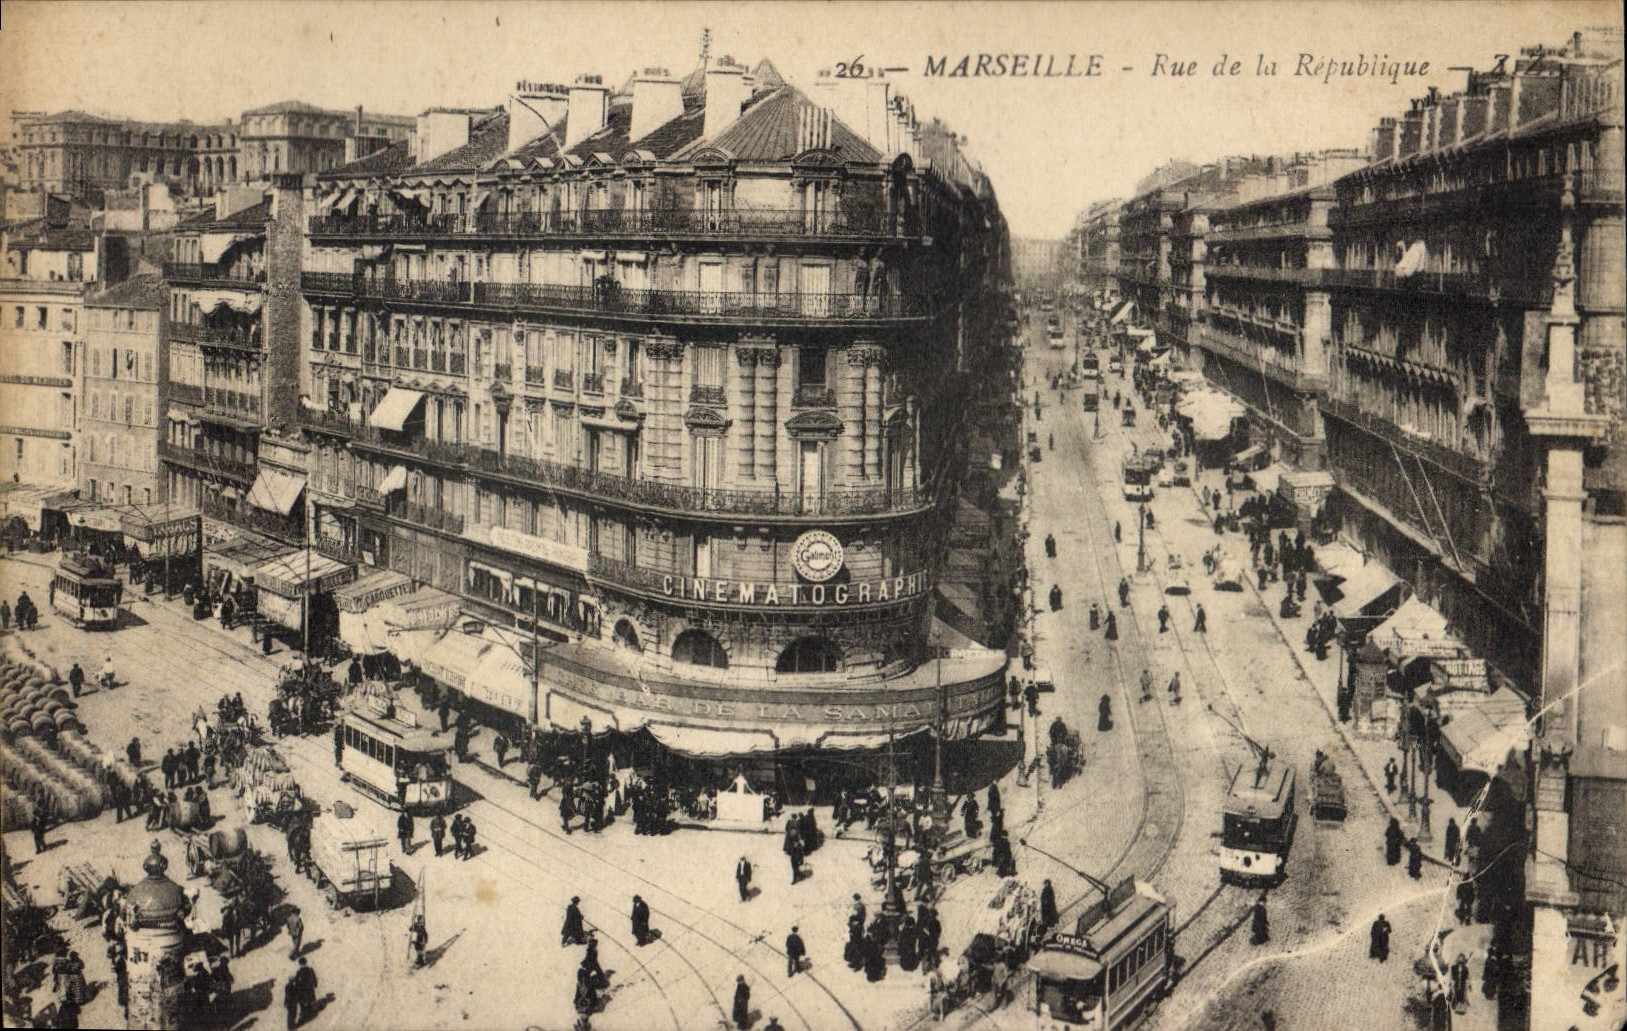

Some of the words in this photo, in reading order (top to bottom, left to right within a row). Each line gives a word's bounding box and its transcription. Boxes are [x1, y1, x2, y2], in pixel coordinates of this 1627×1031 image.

[692, 700, 737, 717] DE
[757, 704, 803, 720] LA
[1056, 933, 1088, 949] OMEGA
